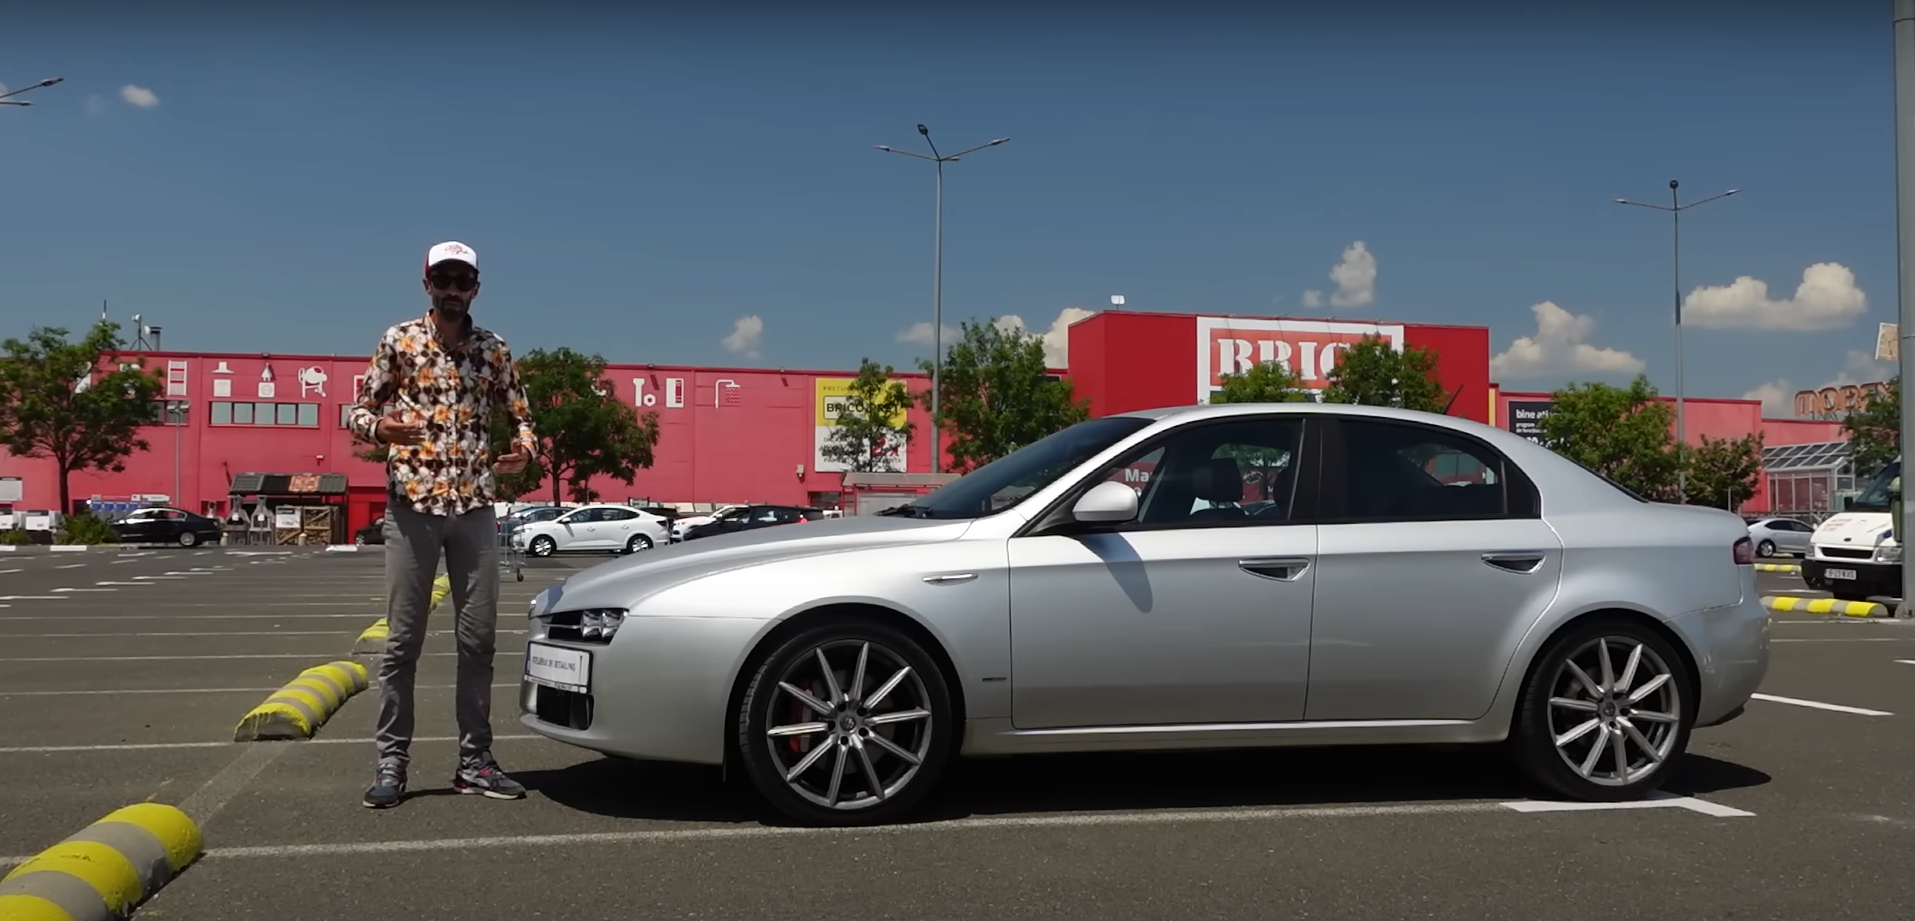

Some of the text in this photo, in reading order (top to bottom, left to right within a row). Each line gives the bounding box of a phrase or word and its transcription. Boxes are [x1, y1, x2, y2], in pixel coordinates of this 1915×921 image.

[1217, 338, 1372, 382] BRIC
[826, 403, 864, 413] BRICO
[1516, 409, 1535, 419] bine
[1125, 468, 1152, 482] Ma
